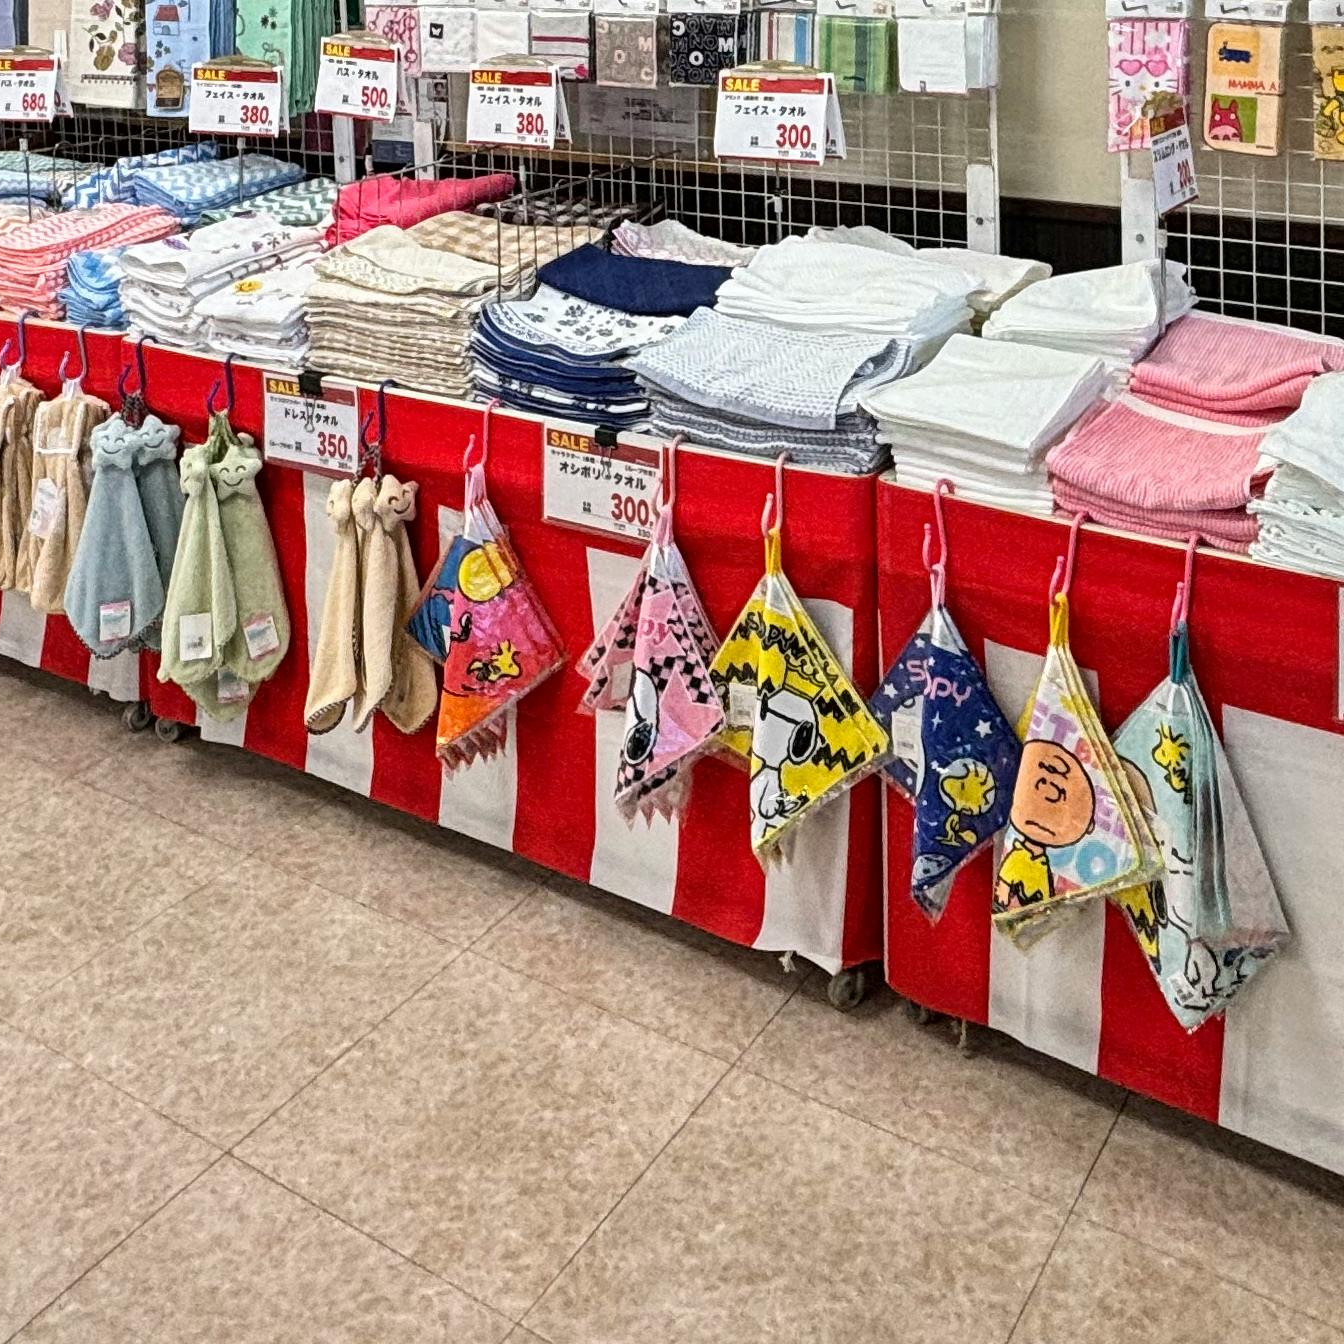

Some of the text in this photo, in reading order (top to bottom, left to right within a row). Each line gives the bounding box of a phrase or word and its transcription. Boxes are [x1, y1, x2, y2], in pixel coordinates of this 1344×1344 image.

[325, 44, 351, 56] SALE
[196, 69, 227, 80] SALE
[473, 71, 503, 85] SALE
[724, 79, 761, 93] SALE
[205, 90, 265, 101] フェイス・タオル
[479, 94, 543, 107] フェイス・タオル
[734, 103, 807, 118] フェイス・タオル
[269, 379, 301, 395] SALE
[550, 431, 590, 452] SALE
